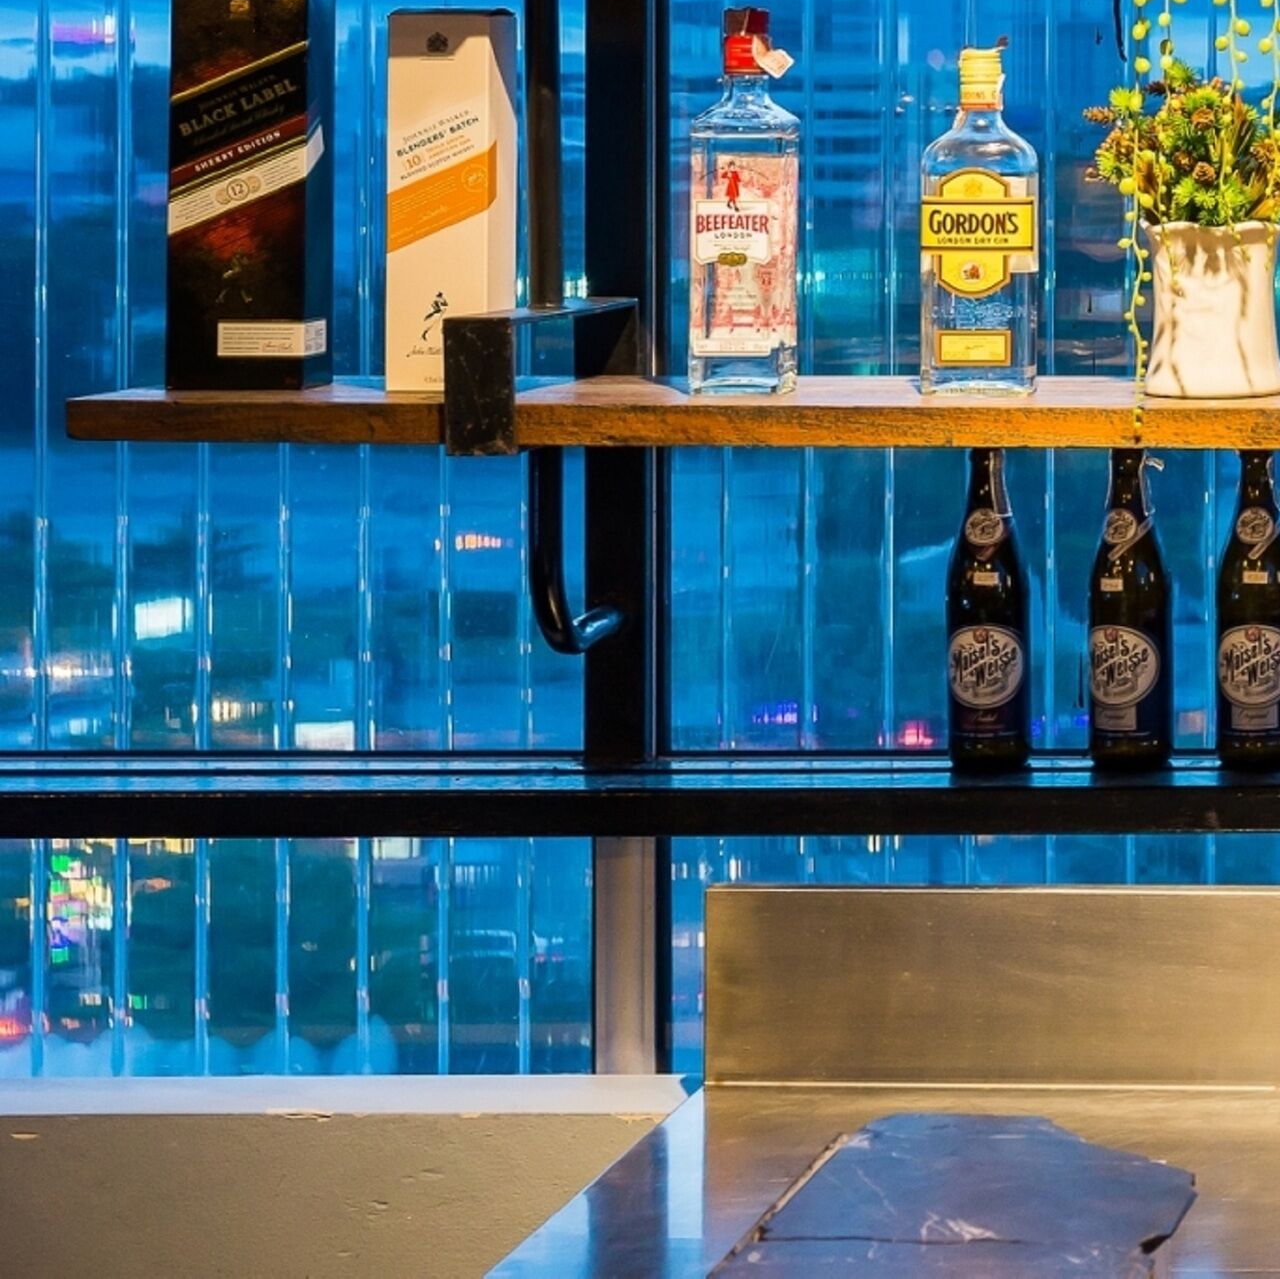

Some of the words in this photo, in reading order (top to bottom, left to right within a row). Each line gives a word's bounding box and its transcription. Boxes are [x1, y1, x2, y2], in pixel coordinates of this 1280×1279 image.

[178, 103, 238, 137] BLACK
[241, 79, 296, 110] LABEL
[449, 116, 479, 133] BATCH
[194, 150, 234, 172] SHERRY
[237, 131, 281, 153] EDITION
[406, 154, 421, 170] 10
[230, 182, 244, 196] 12
[696, 213, 769, 235] BEEFEATER
[929, 209, 1019, 235] GORDON'S
[714, 232, 753, 240] LONDON
